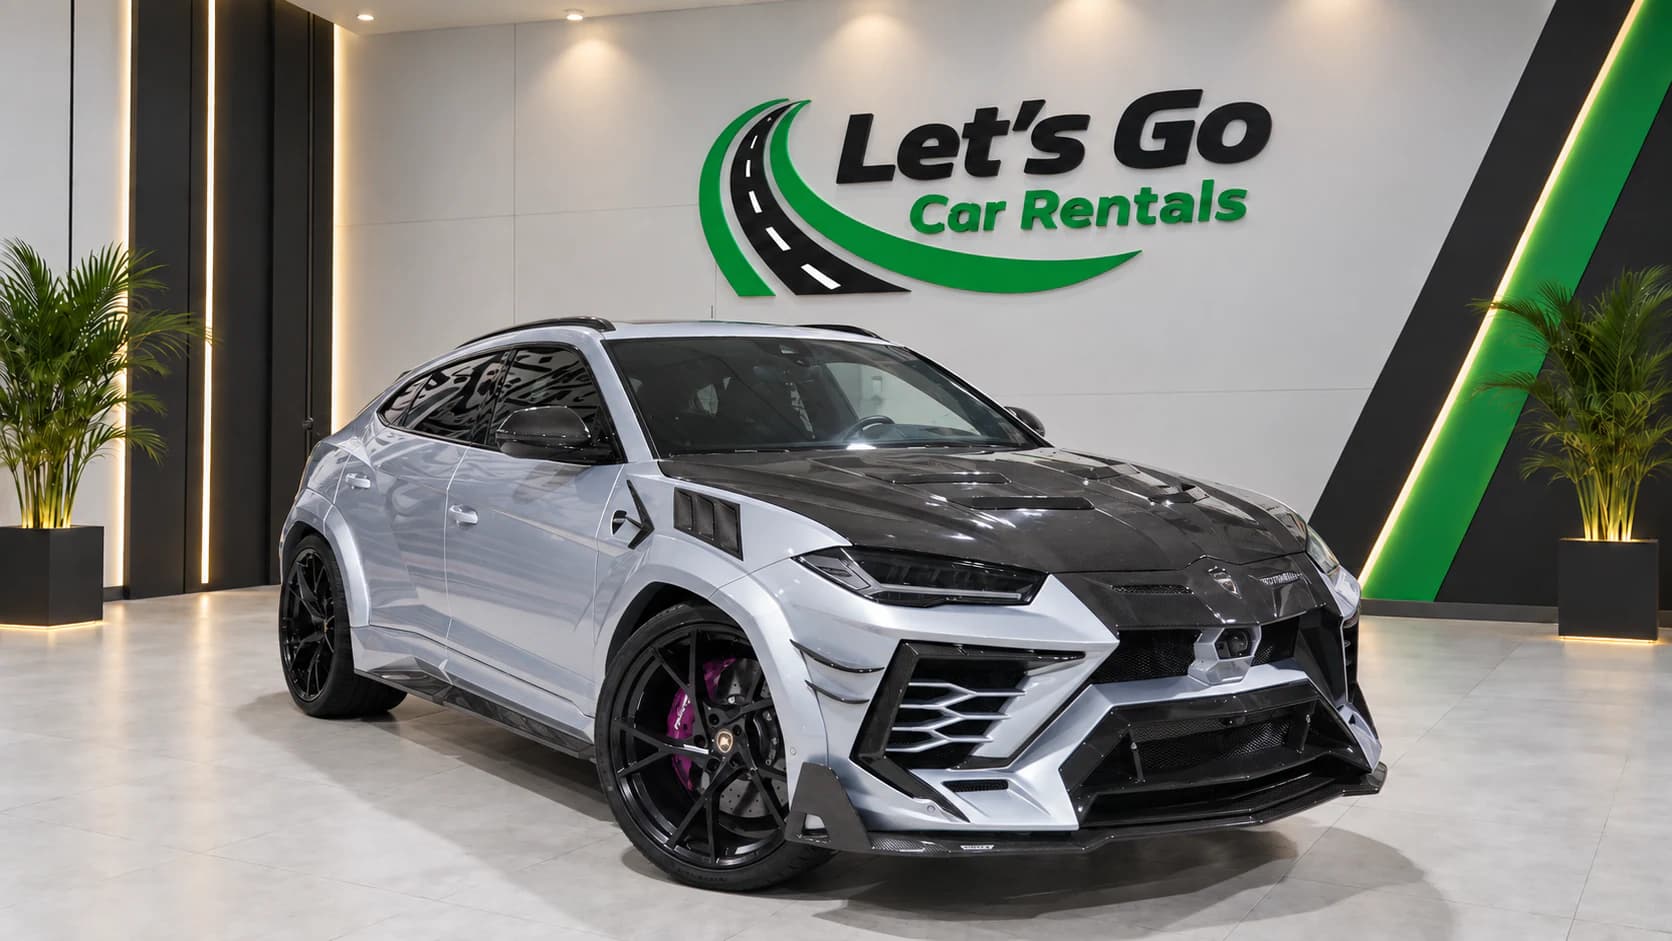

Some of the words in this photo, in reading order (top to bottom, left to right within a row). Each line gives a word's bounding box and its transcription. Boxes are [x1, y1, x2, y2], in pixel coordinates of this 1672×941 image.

[835, 99, 1092, 185] Let's
[1113, 88, 1273, 170] Go
[909, 194, 1007, 235] Car
[1020, 179, 1249, 231] Rentals
